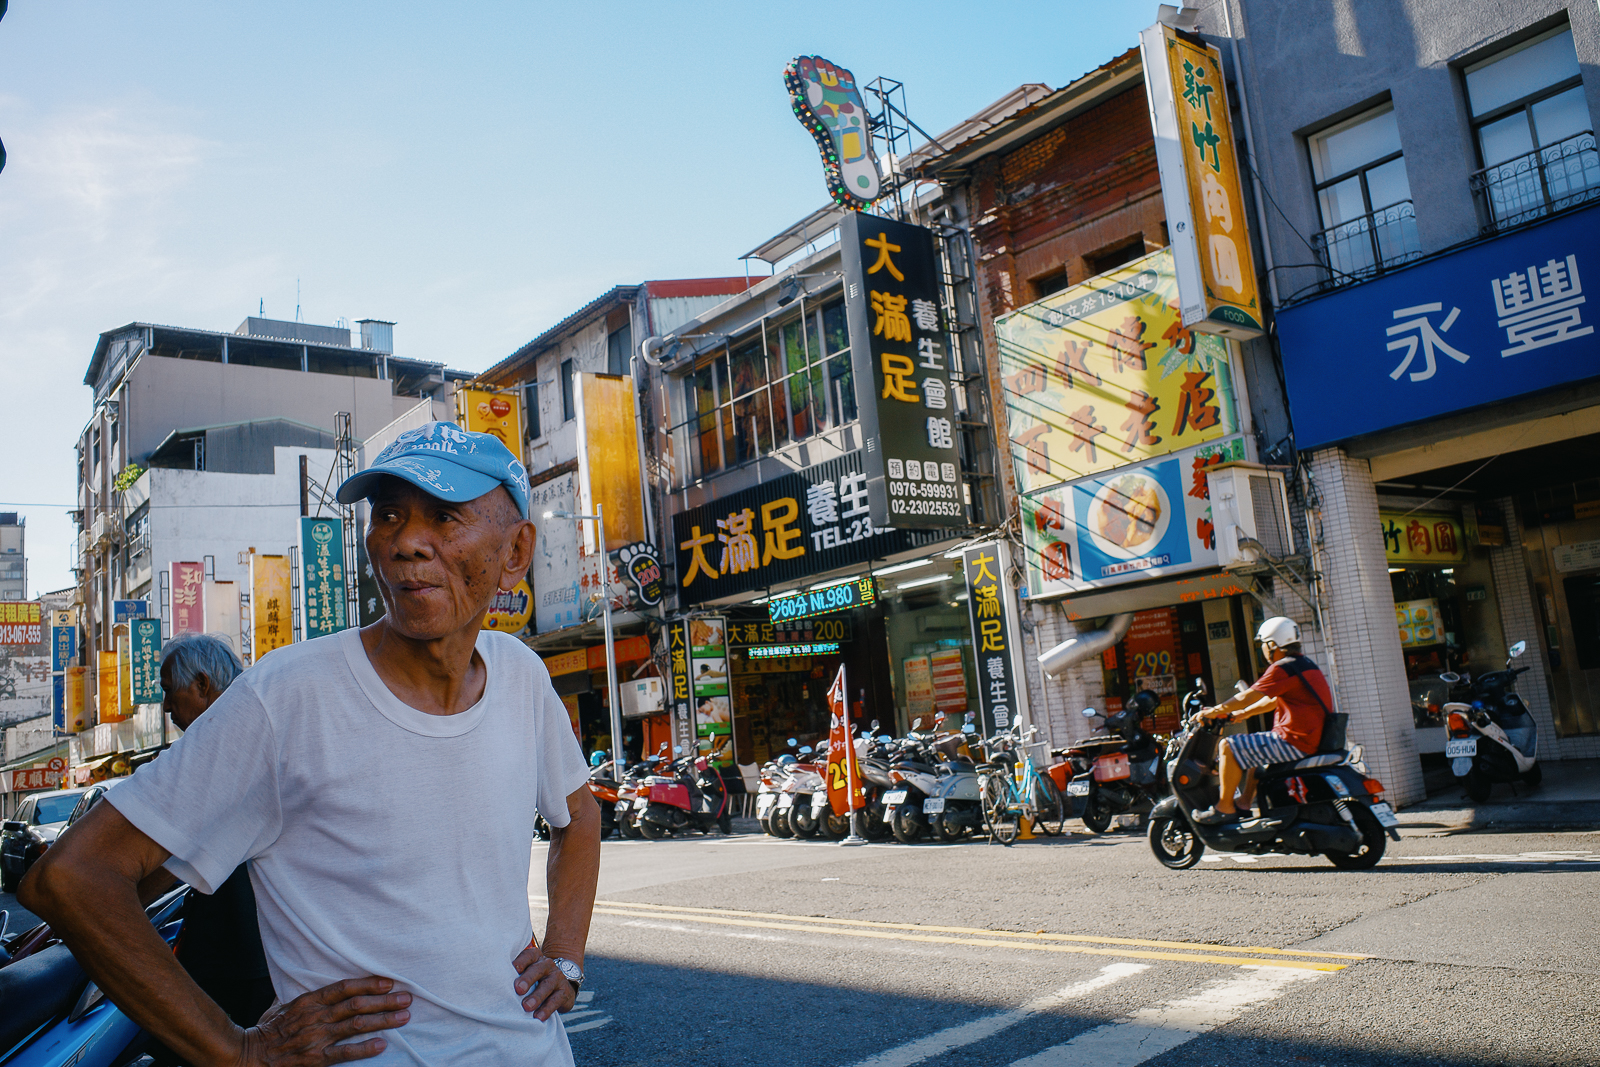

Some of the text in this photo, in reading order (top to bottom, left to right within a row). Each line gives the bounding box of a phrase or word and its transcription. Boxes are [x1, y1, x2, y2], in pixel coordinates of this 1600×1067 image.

[864, 232, 920, 403] 大滿足
[1223, 309, 1245, 323] FOOD
[1385, 253, 1595, 382] 永豐
[911, 298, 953, 449] 養生會館
[1008, 371, 1221, 476] 百年老店
[889, 460, 956, 481] 預約電話
[806, 470, 870, 526] 養生
[889, 481, 958, 499] 0976-599931
[891, 499, 961, 516] 02-23025532
[680, 497, 805, 588] 大滿足
[810, 516, 897, 552] TEL:23
[637, 565, 661, 586] 200
[543, 587, 576, 607] 刮刮樂
[809, 585, 852, 611] Nt.980
[970, 552, 1005, 653] 大滿足
[728, 623, 775, 644] 大滿足
[814, 620, 844, 640] 200
[1211, 627, 1228, 638] 165
[670, 624, 688, 700] 大滿足
[1133, 650, 1170, 677] 299
